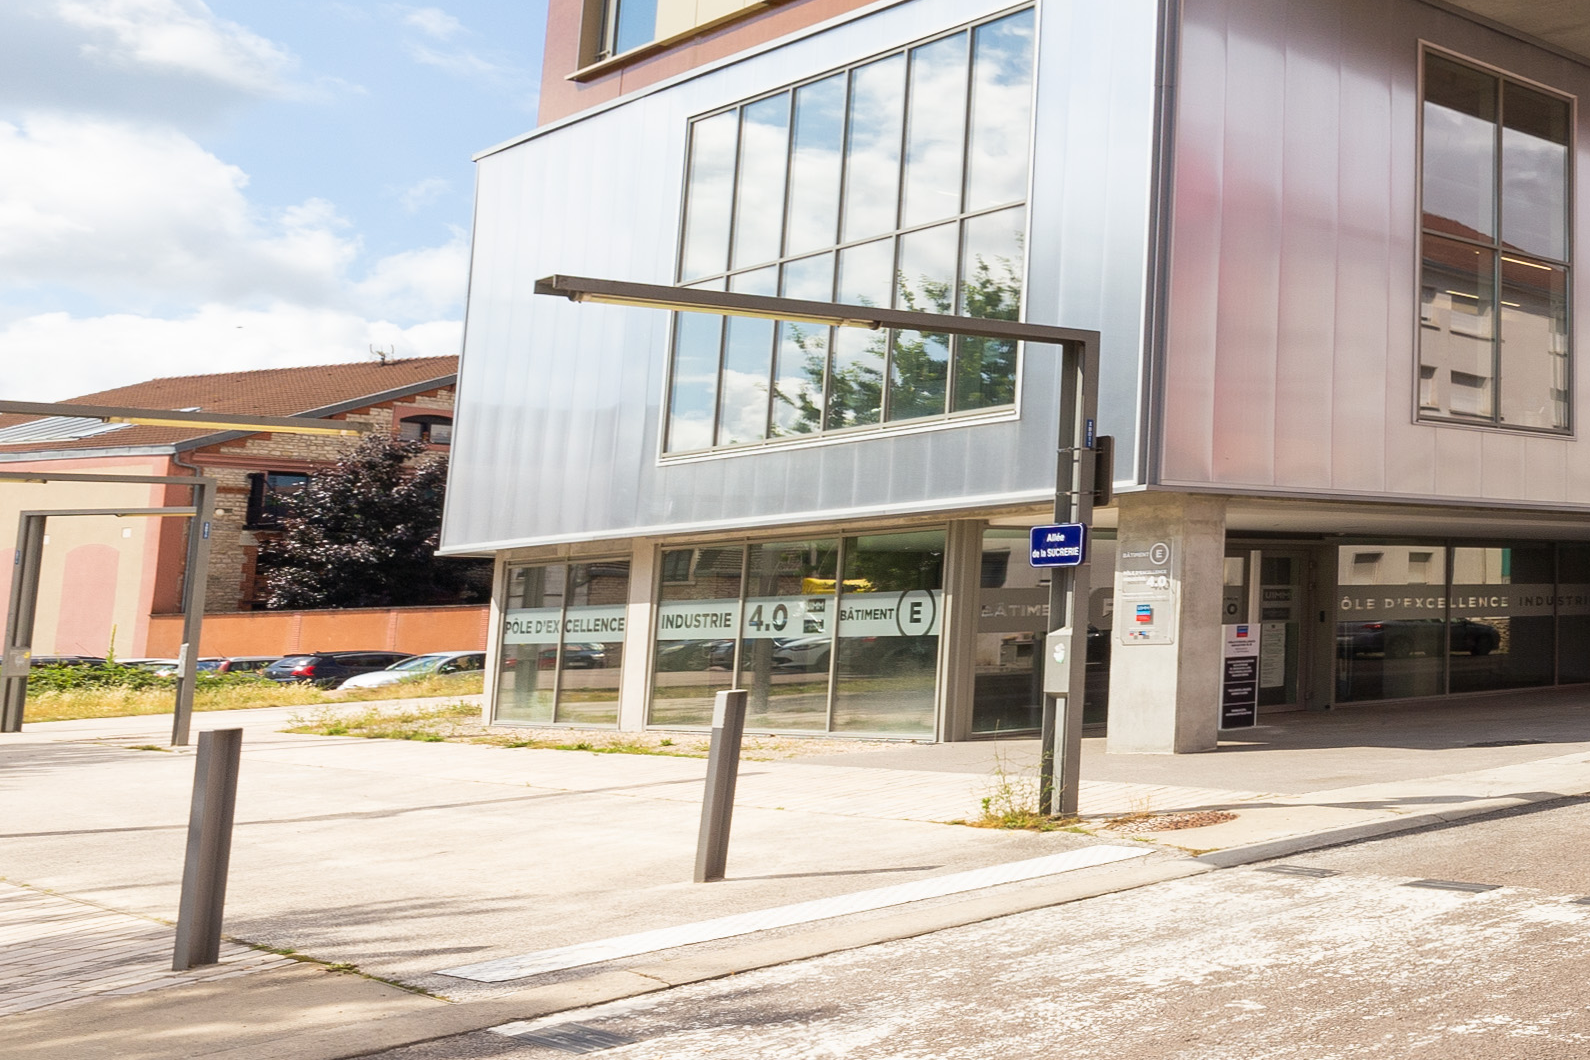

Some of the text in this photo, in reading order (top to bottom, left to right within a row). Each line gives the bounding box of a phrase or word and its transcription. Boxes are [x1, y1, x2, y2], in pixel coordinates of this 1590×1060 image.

[1046, 533, 1065, 542] Allée
[1032, 547, 1080, 558] de la SUCRERIE
[1156, 549, 1163, 558] E
[981, 602, 1050, 617] BÂTIME
[1341, 596, 1375, 610] ÔLE
[1384, 597, 1509, 609] D'EXCELLENCE
[505, 618, 532, 635] PÔLE
[535, 618, 625, 634] D'EXCELLENCE
[661, 612, 732, 629] INDUSTRIE
[748, 603, 788, 631] 4.0
[840, 601, 923, 623] BÂTIMENT E
